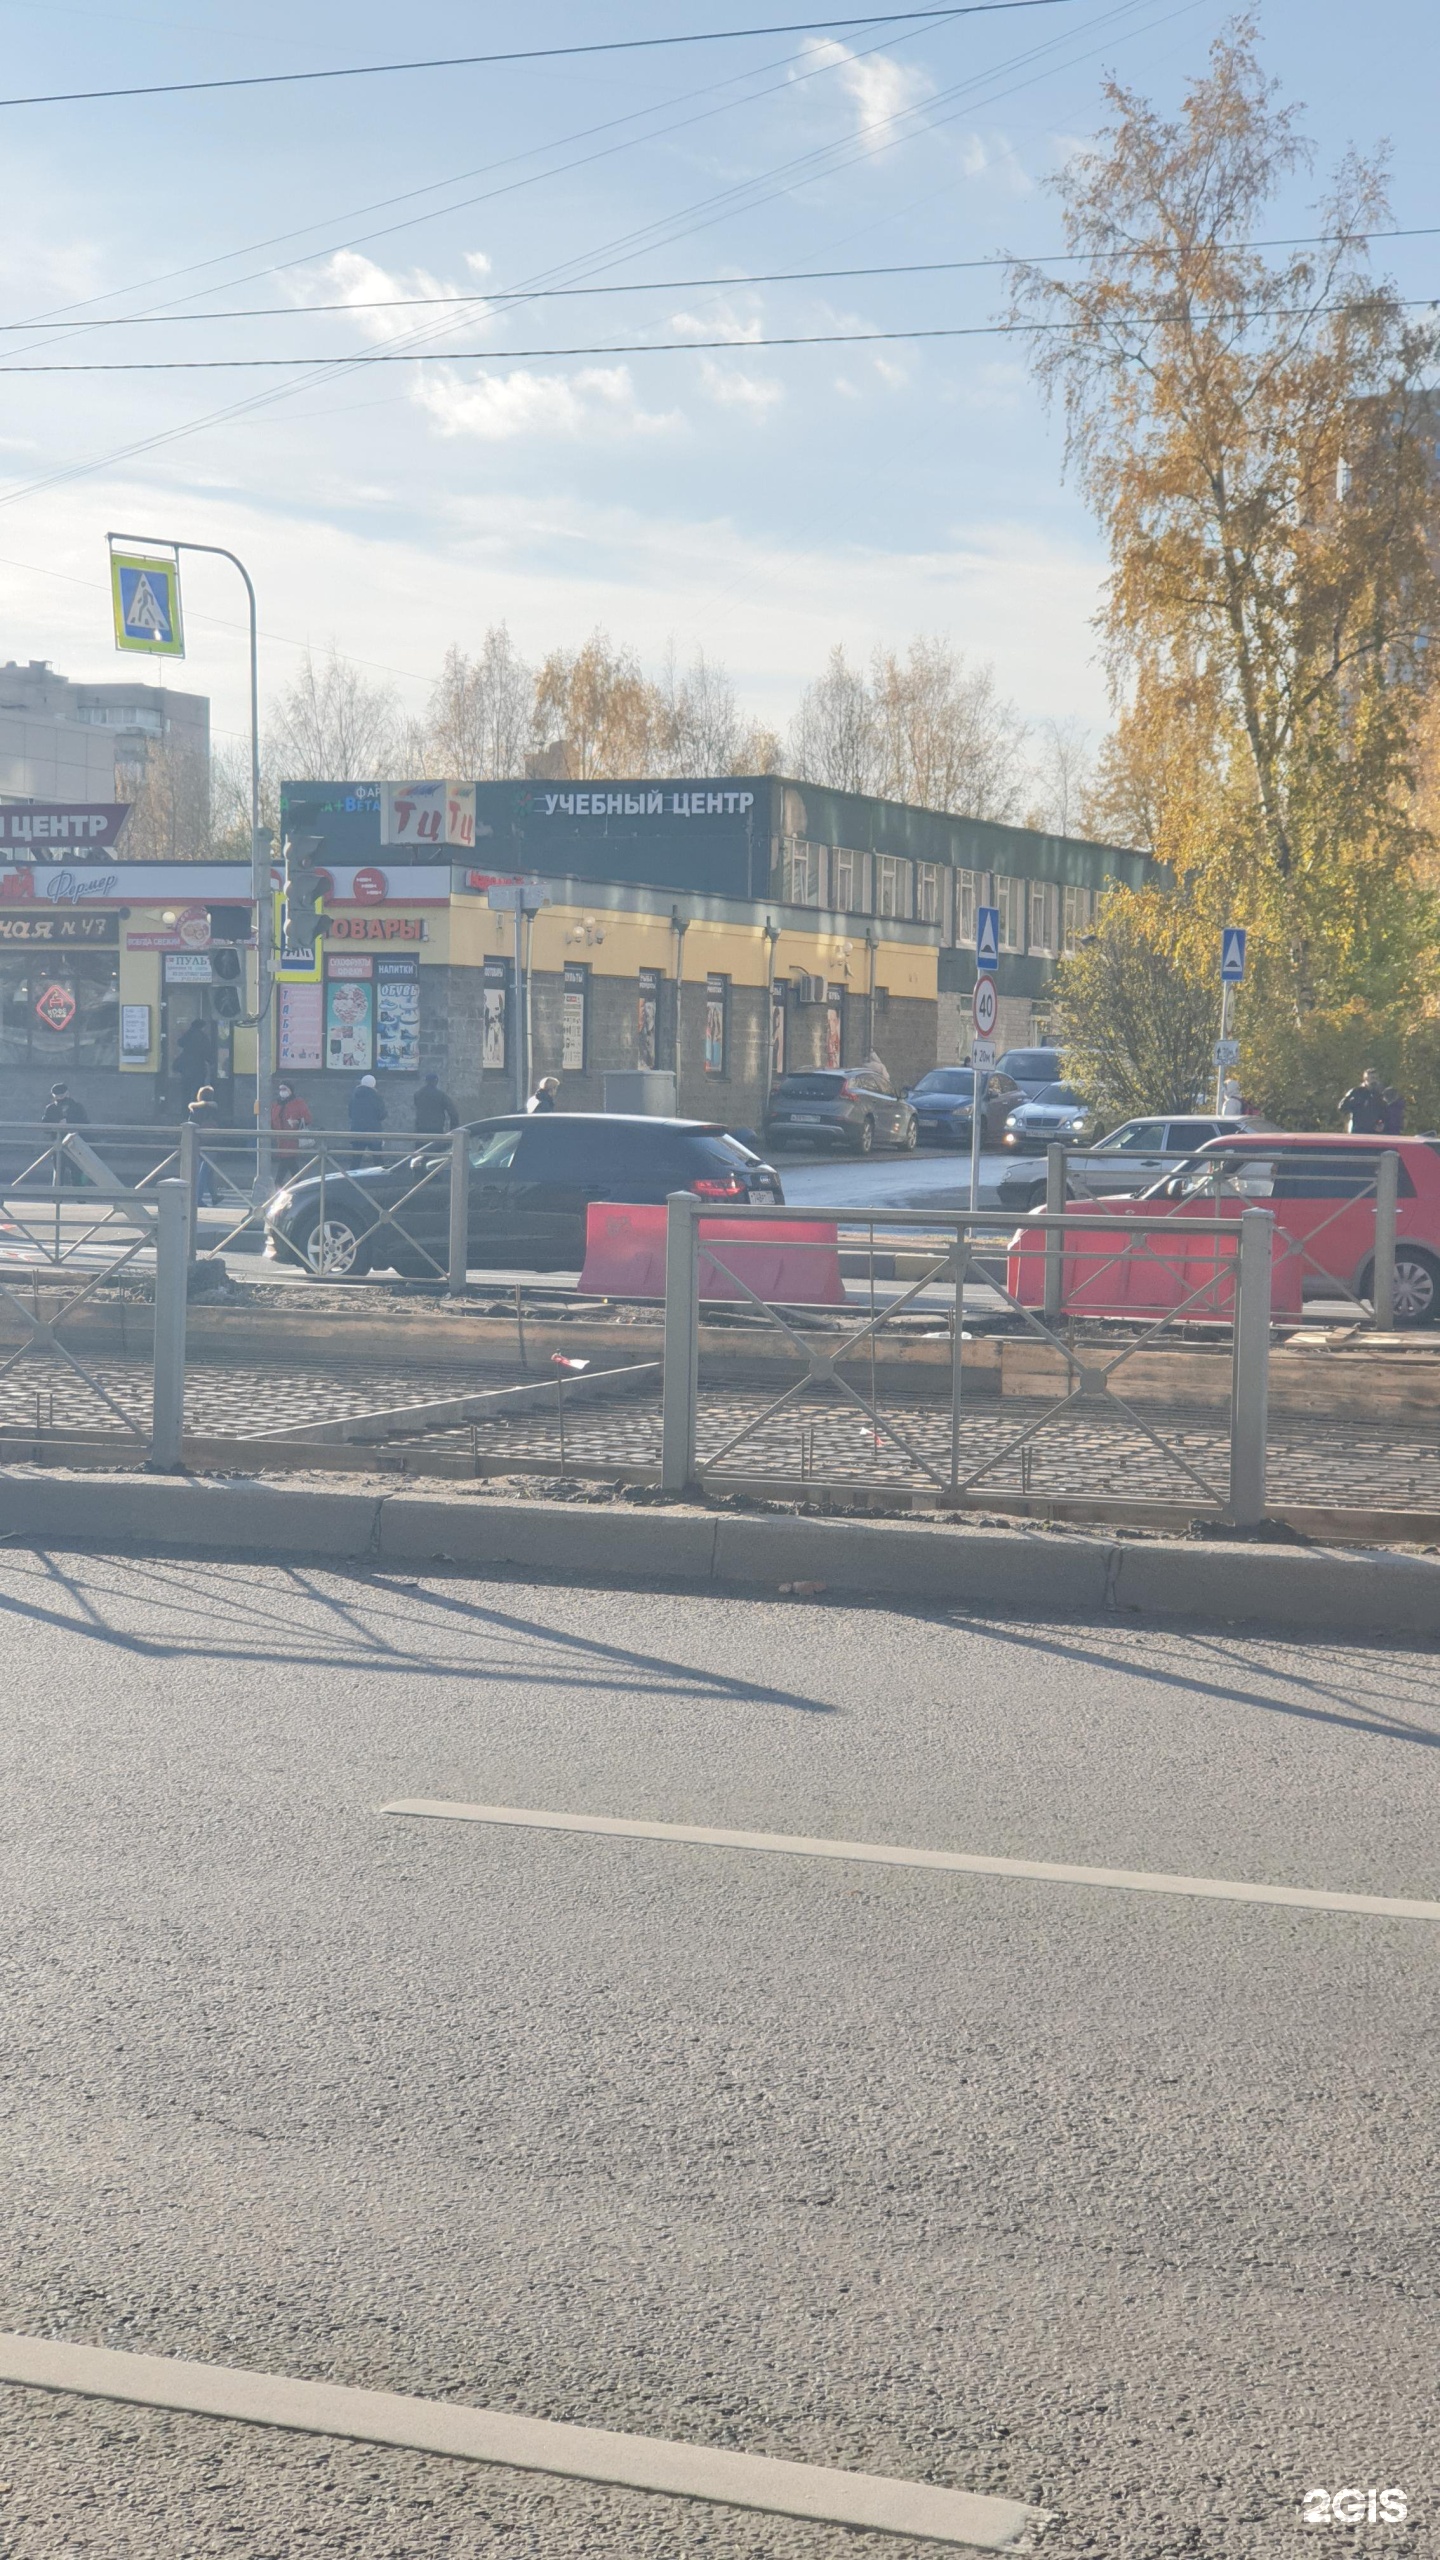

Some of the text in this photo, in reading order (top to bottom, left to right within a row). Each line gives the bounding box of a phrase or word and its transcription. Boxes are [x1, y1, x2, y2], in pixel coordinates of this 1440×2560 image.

[545, 789, 754, 817] УЧЕБНЫЙ ЦЕНТР
[11, 814, 108, 841] ЦЕНТР
[46, 870, 118, 904] Фермер
[325, 918, 429, 942] ОВАРЫ!
[378, 965, 414, 975] НАПИТКИ
[380, 985, 417, 997] ОБУВЬ
[979, 994, 993, 1018] 40
